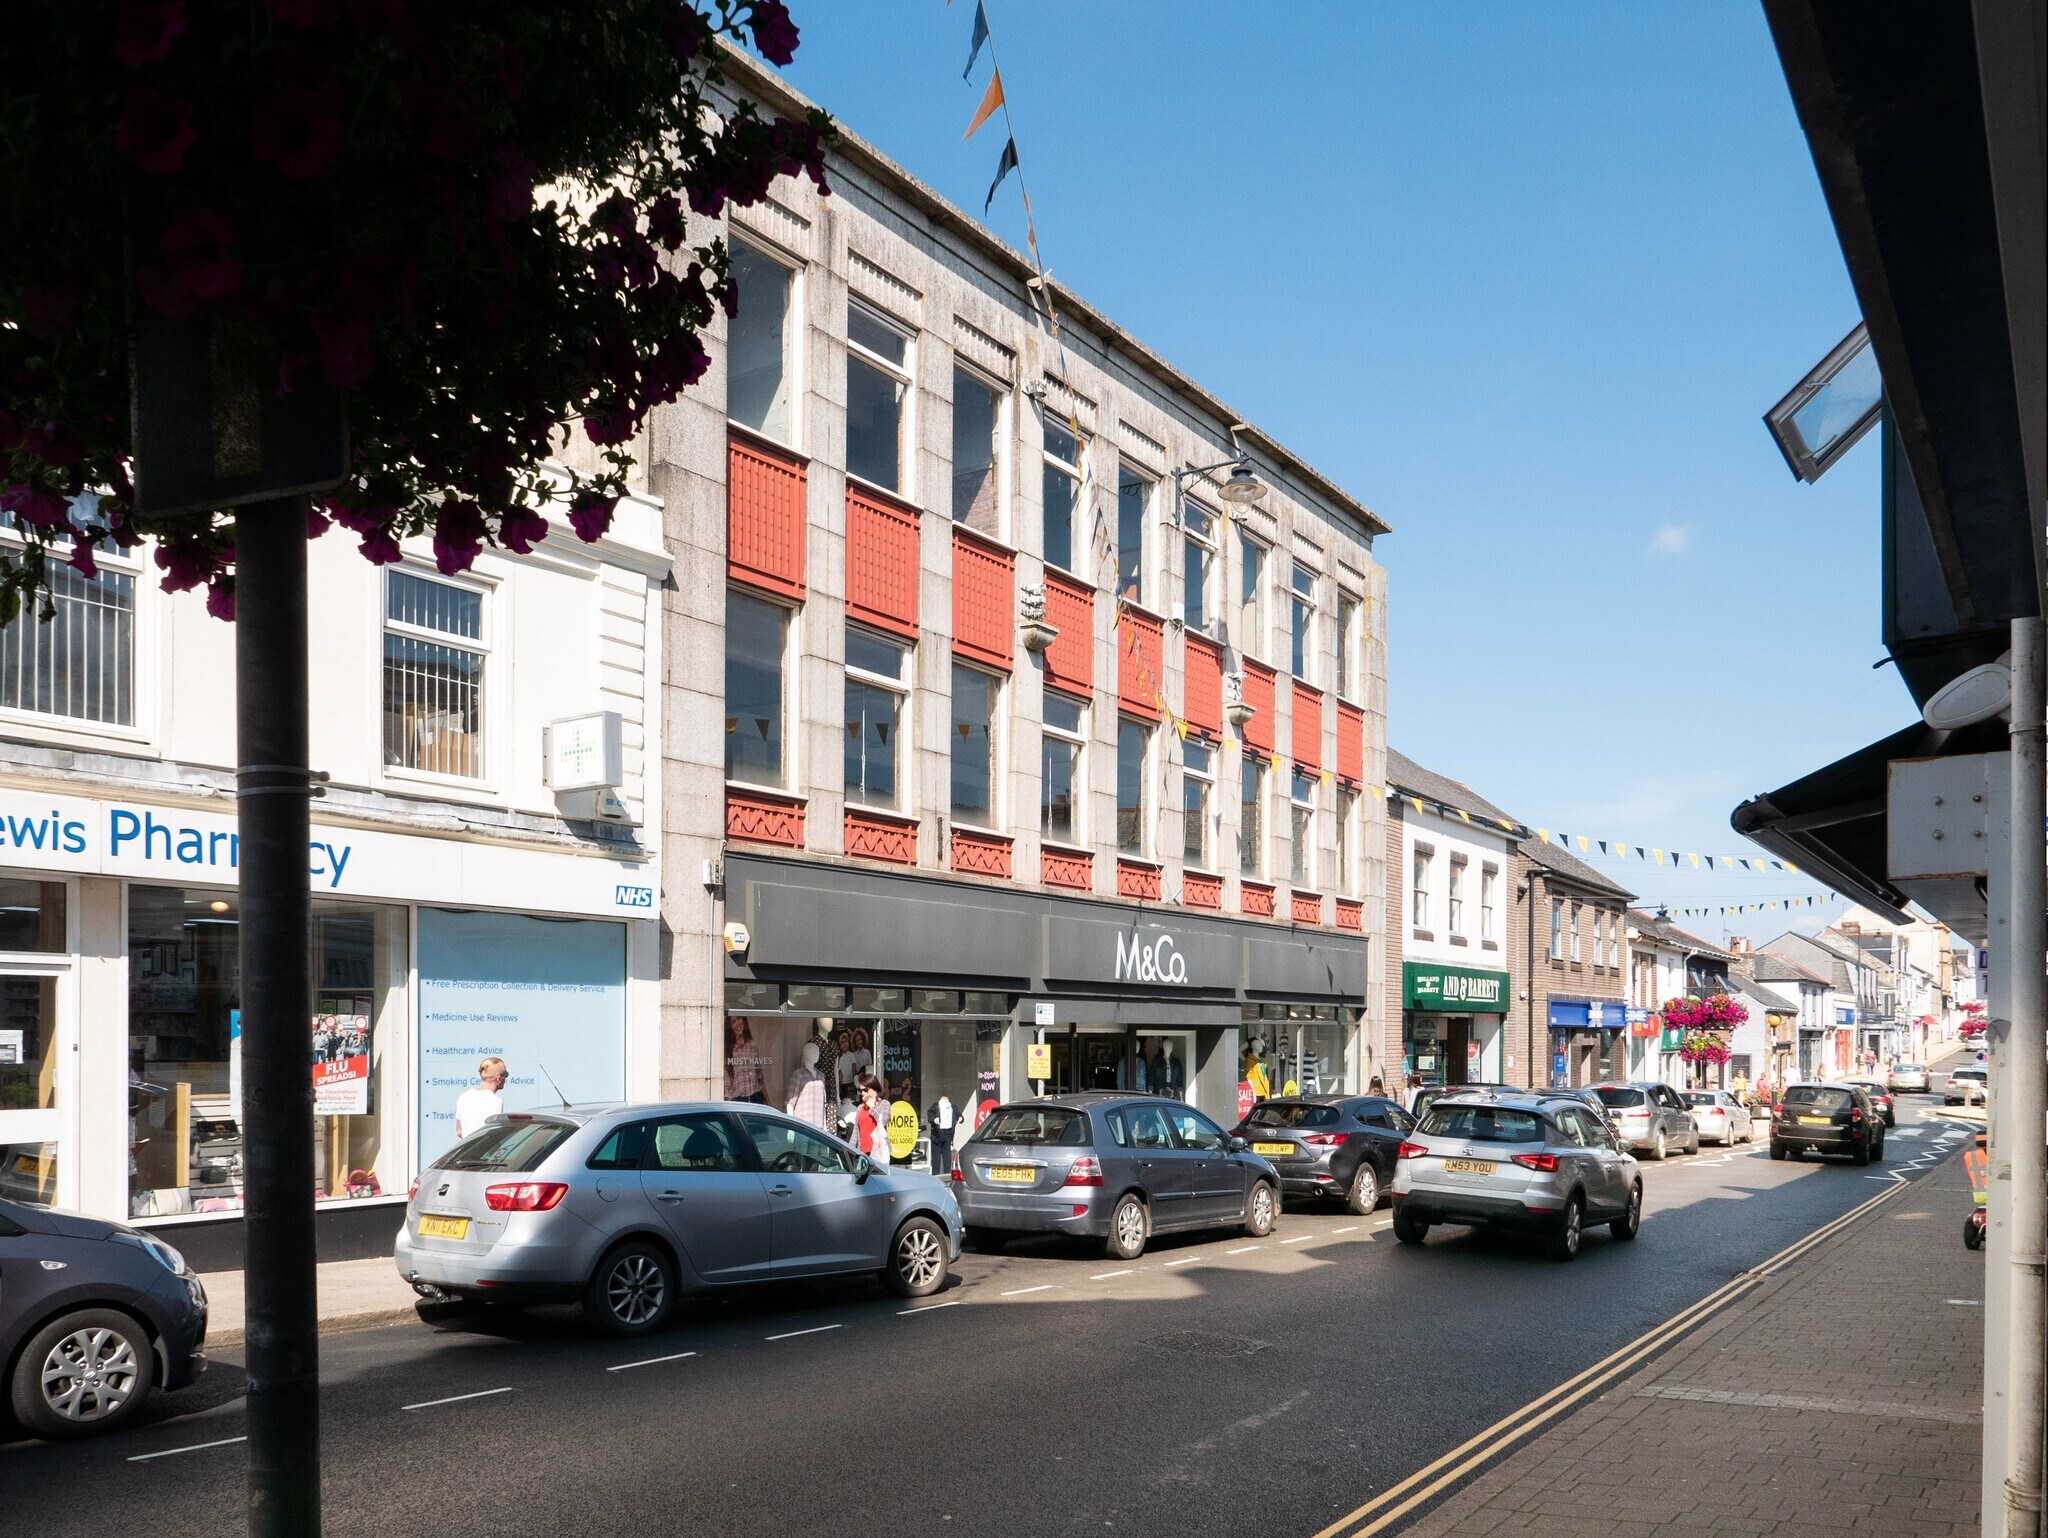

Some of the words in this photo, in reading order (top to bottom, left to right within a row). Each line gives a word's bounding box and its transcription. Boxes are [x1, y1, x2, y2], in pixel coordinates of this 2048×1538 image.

[0, 810, 86, 853] wis
[111, 809, 351, 887] Pharcy
[616, 887, 651, 905] NHS
[1115, 931, 1188, 983] M&Co.
[432, 980, 450, 988] Free
[452, 980, 499, 991] Prescription
[501, 981, 538, 991] Collection
[540, 983, 546, 991] &
[548, 983, 577, 993] Delivery
[579, 984, 605, 993] Service
[1468, 978, 1500, 1002] BARRETT
[432, 1013, 467, 1022] Medicine
[470, 1014, 485, 1022] Use
[487, 1014, 518, 1022] Reviews
[432, 1046, 475, 1055] Healthcare
[478, 1046, 504, 1055] Advice
[883, 1045, 901, 1056] Back
[727, 1057, 748, 1066] MUST
[749, 1056, 773, 1065] HAVES
[883, 1057, 912, 1072] chool
[325, 1060, 349, 1076] FLU
[317, 1070, 357, 1086] SPREADS!
[432, 1077, 468, 1087] Smoking
[510, 1077, 535, 1085] Advice
[981, 1082, 996, 1091] NOW
[1238, 1089, 1253, 1101] SALE
[888, 1115, 914, 1128] MORE
[1473, 1162, 1492, 1173] YOU
[990, 1168, 1013, 1179] RE05
[1015, 1169, 1034, 1180] FHK
